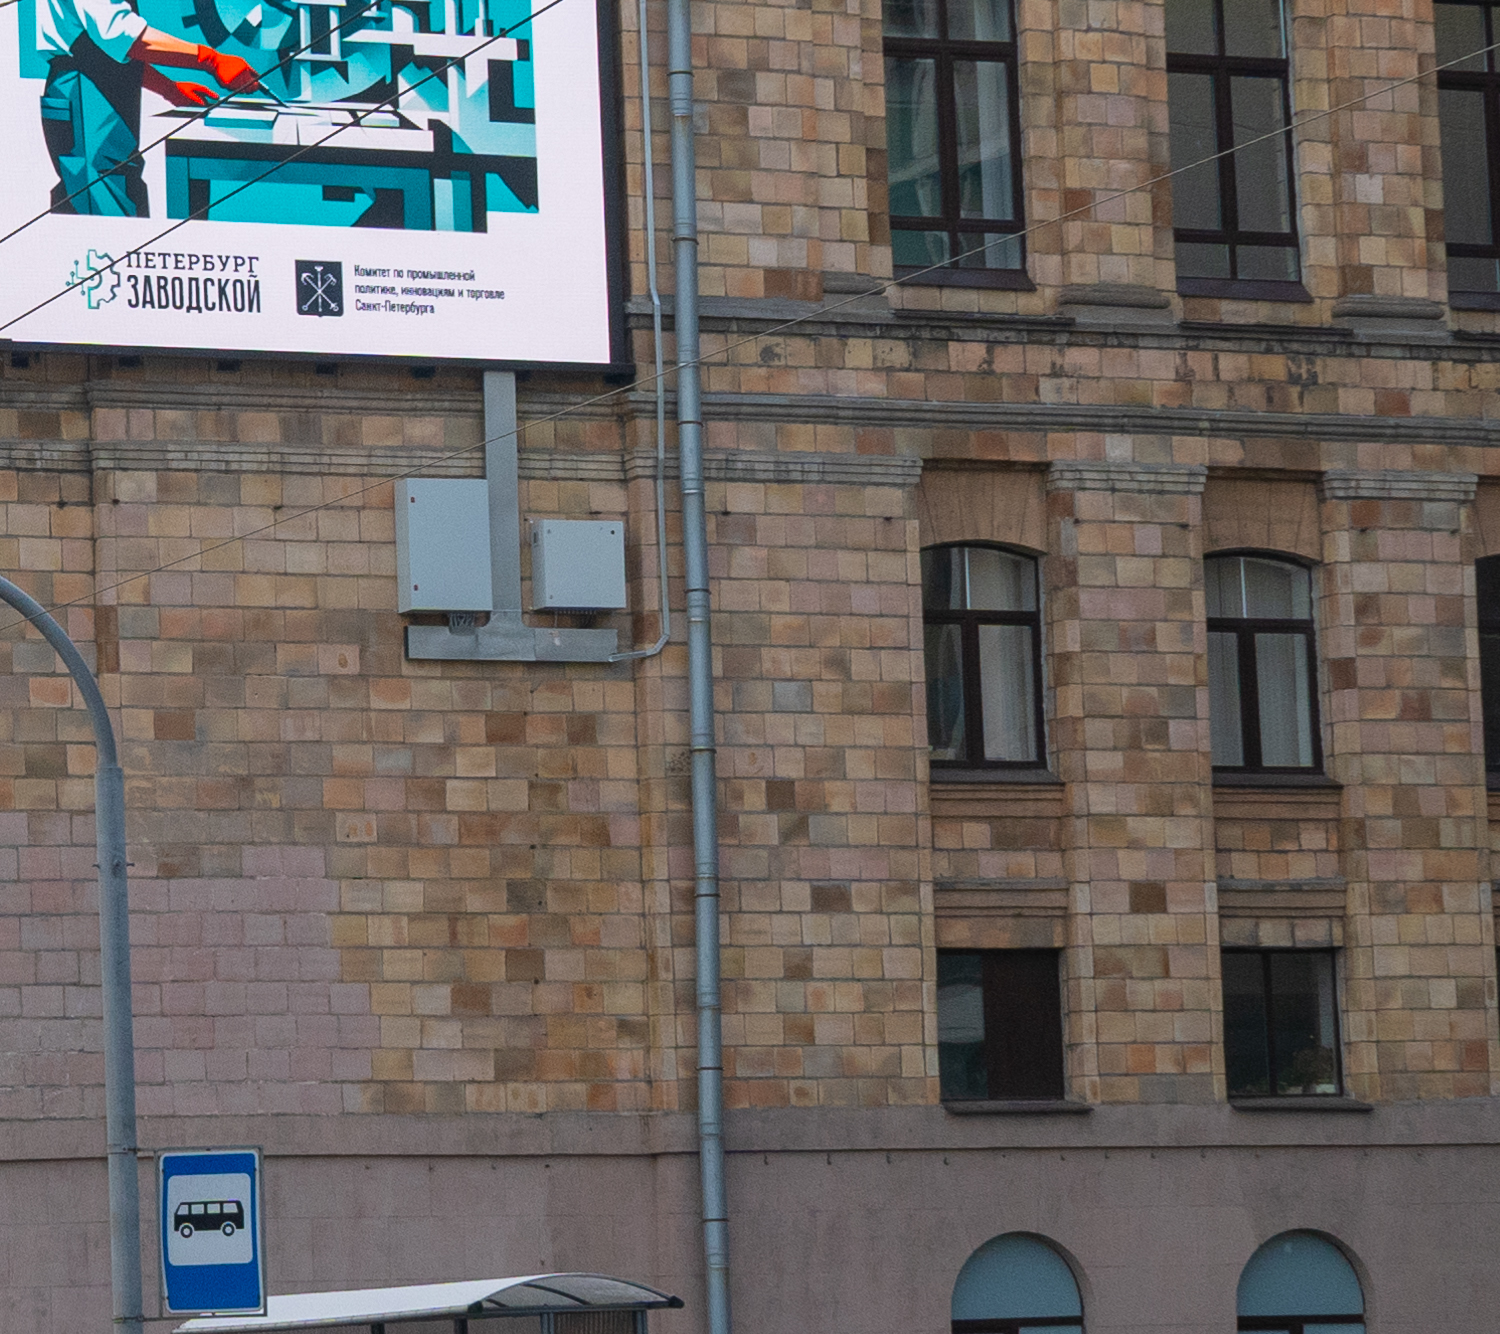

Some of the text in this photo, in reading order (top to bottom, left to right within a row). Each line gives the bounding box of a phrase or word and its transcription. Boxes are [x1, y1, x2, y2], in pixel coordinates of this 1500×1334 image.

[126, 251, 260, 274] ПЕТЕРБУРГ
[354, 265, 476, 281] Комитет по промышленной
[127, 274, 262, 314] ЗАВОДСКОЙ
[354, 284, 506, 301] политике, инновациям и торговле
[355, 299, 436, 316] Санкт-Петербурга
